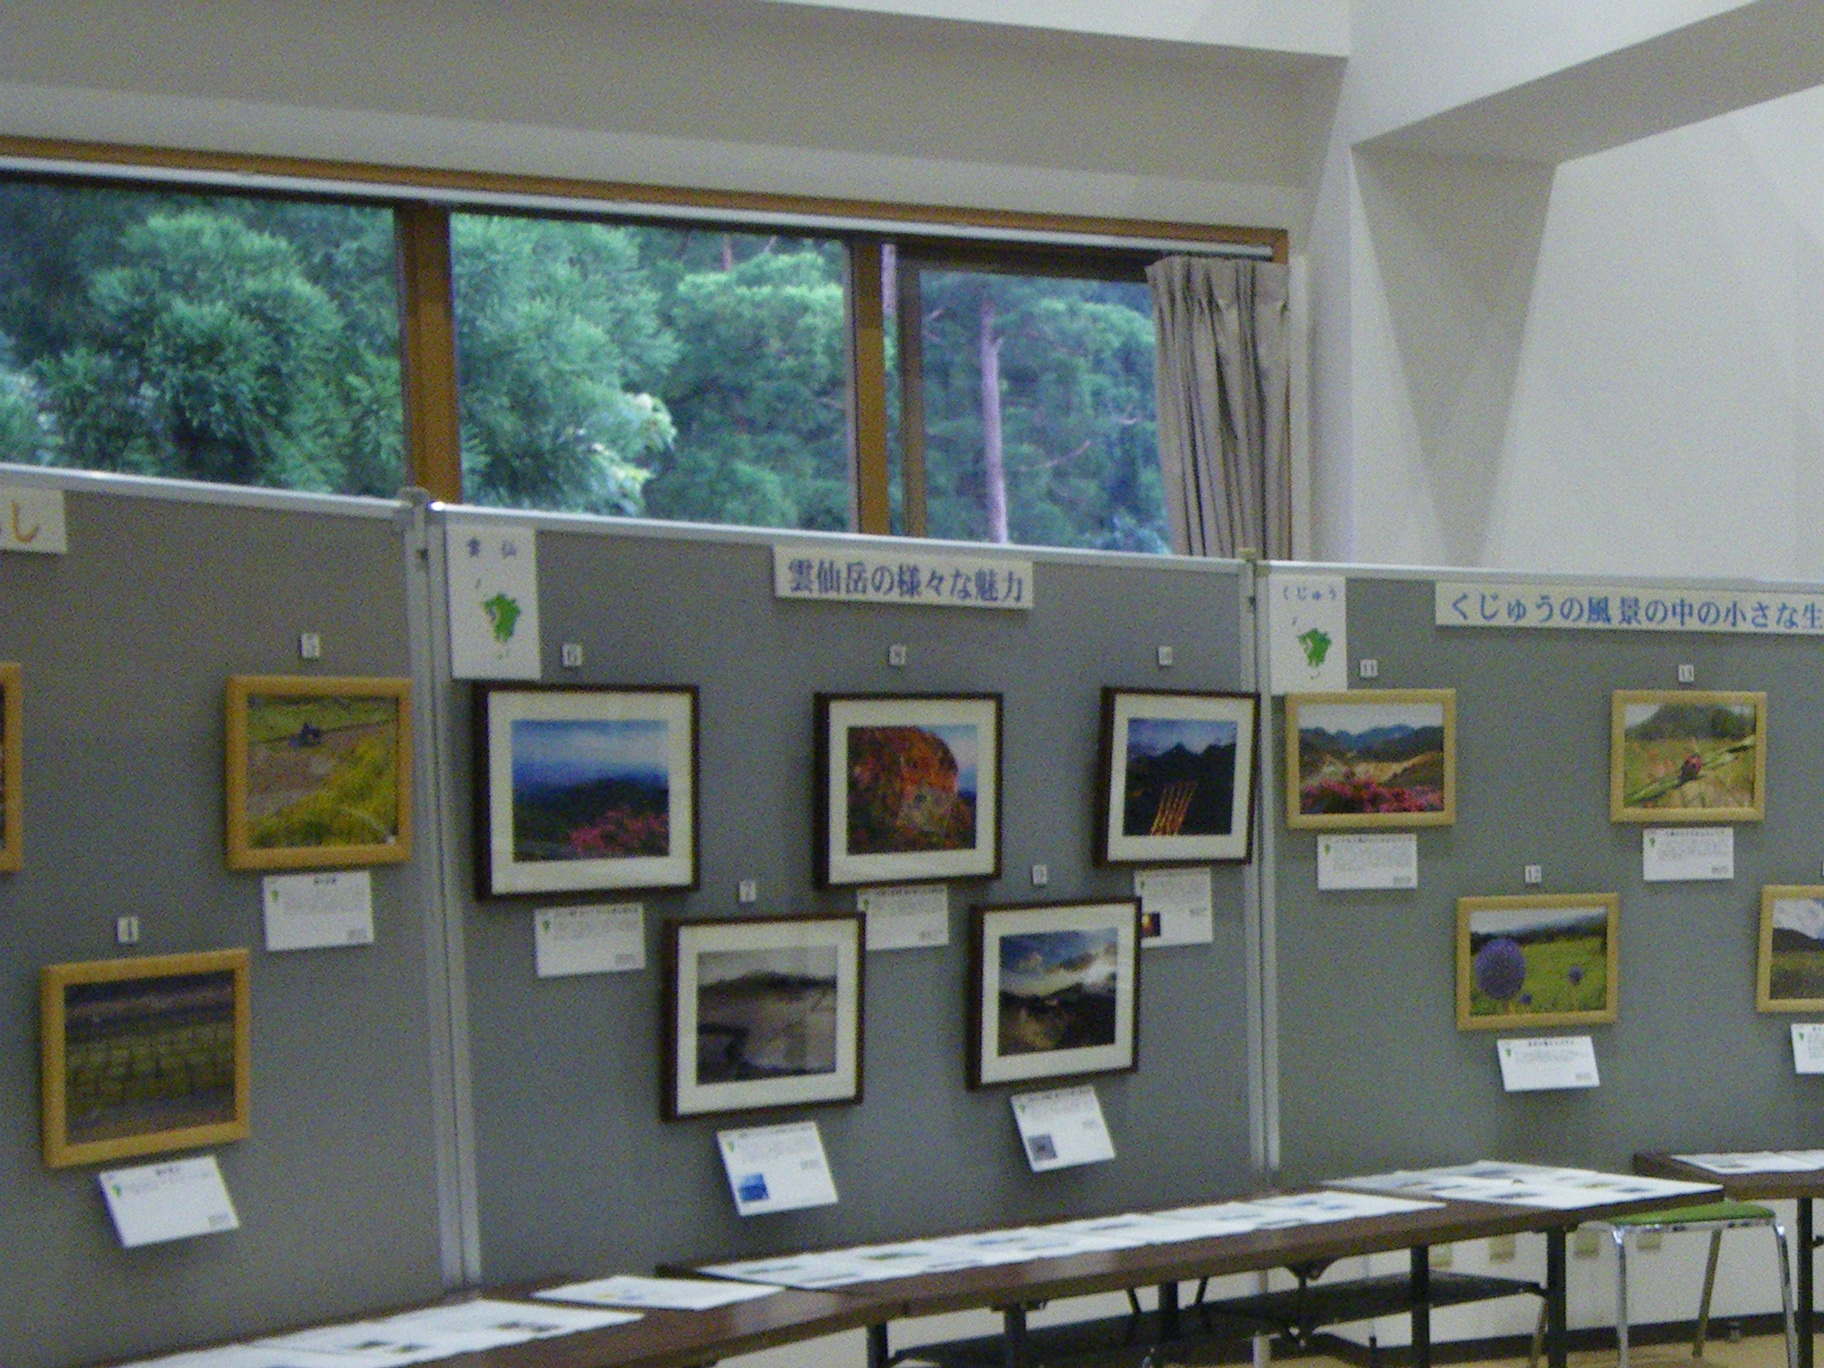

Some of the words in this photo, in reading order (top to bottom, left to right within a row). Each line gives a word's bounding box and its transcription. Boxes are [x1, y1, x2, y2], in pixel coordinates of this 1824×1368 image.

[788, 558, 1024, 602] 雲仙岳の様々な魅力
